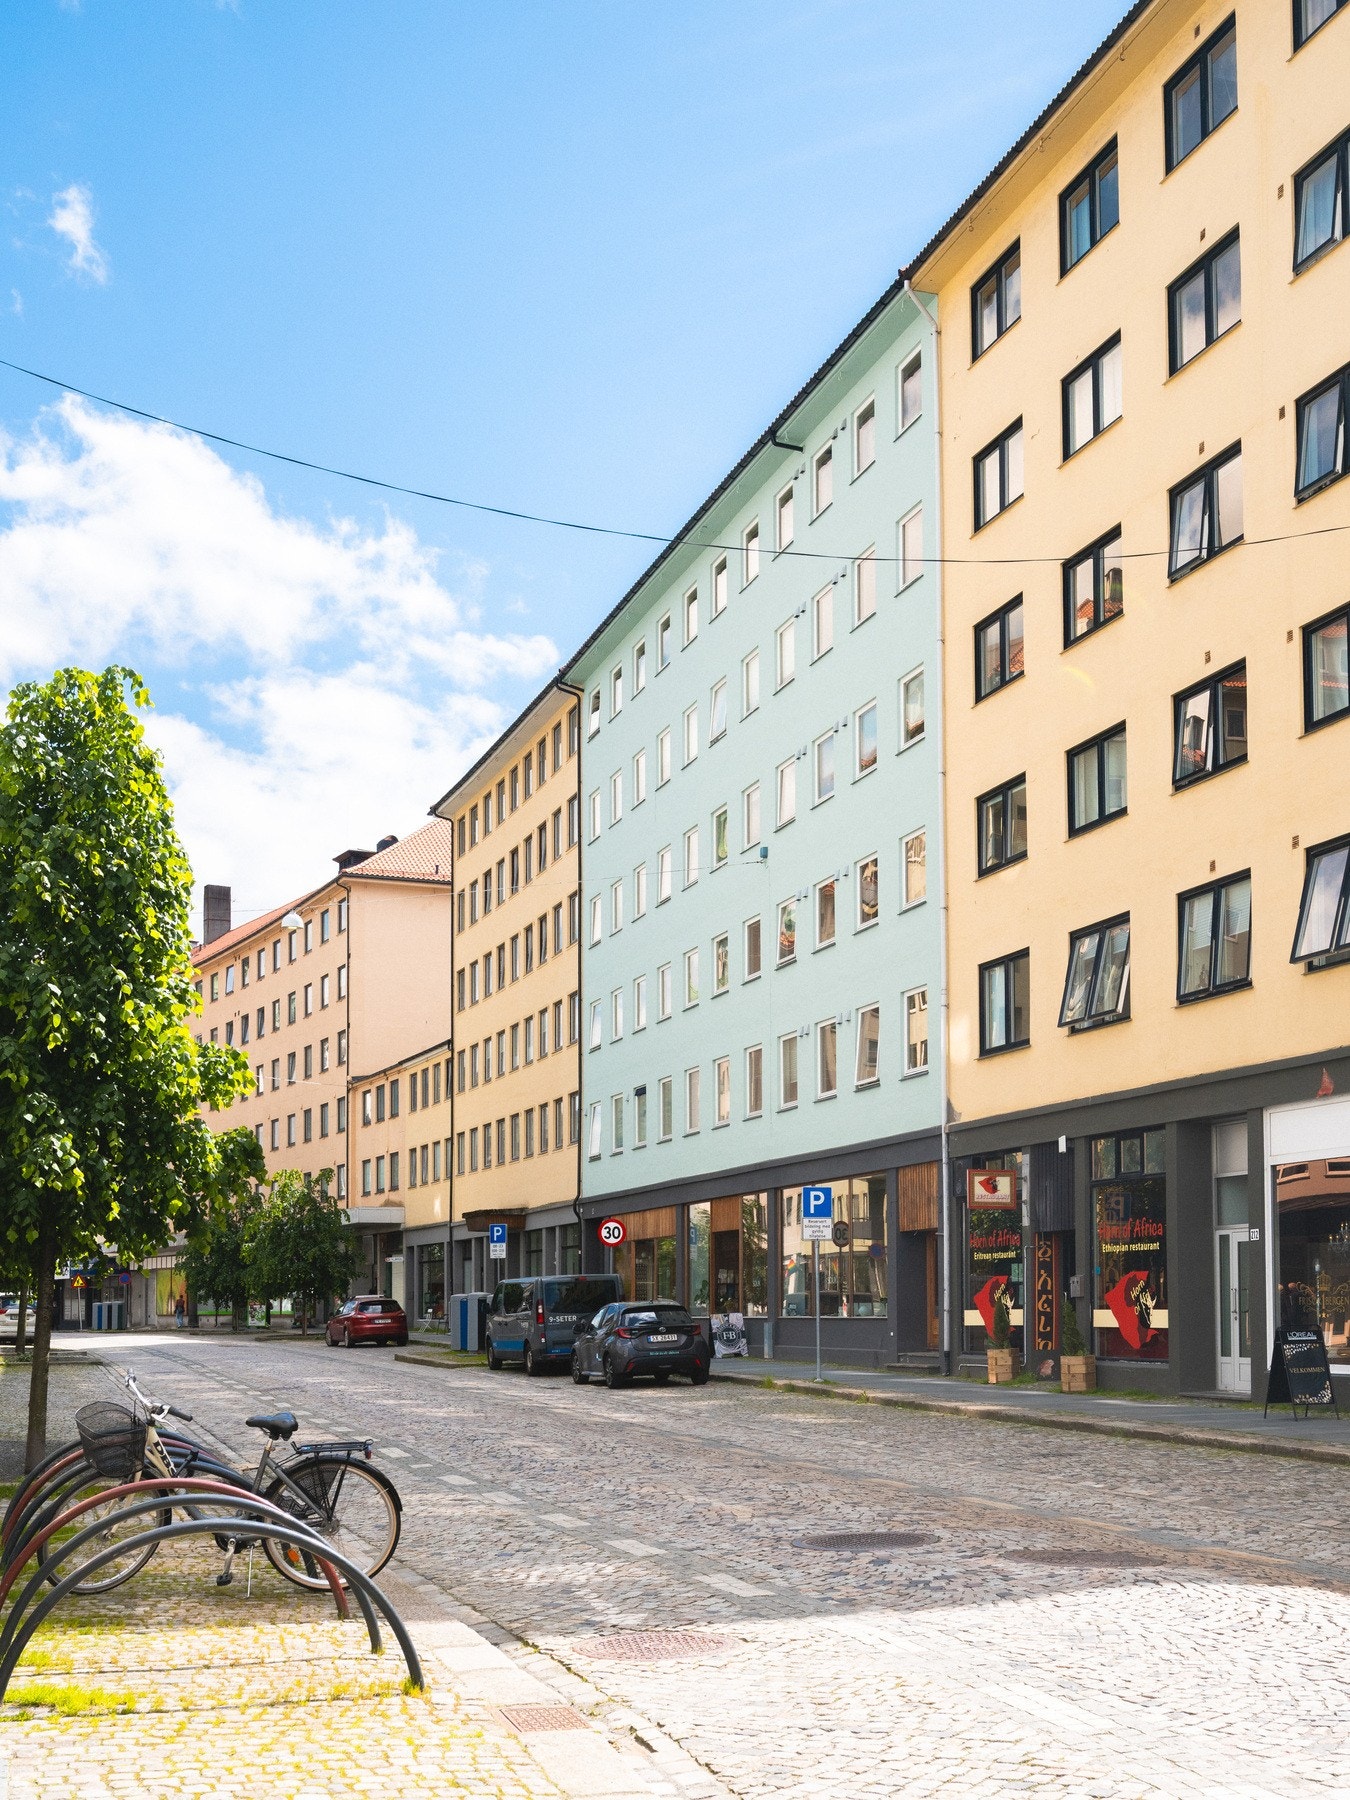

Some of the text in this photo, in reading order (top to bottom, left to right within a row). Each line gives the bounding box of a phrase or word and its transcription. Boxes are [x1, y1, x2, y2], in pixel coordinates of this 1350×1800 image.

[810, 1190, 825, 1214] P
[493, 1226, 503, 1241] P
[603, 1226, 621, 1240] 30
[1099, 1216, 1163, 1240] Horn of Africa
[970, 1228, 1021, 1249] Horn of Africa
[1102, 1241, 1160, 1254] Ethiopian restaurant
[973, 1250, 1016, 1261] Eritrean restaurant
[1130, 1279, 1146, 1301] Horn
[548, 1315, 577, 1323] 9-SETER
[1288, 1366, 1326, 1374] VELKOMMEN
